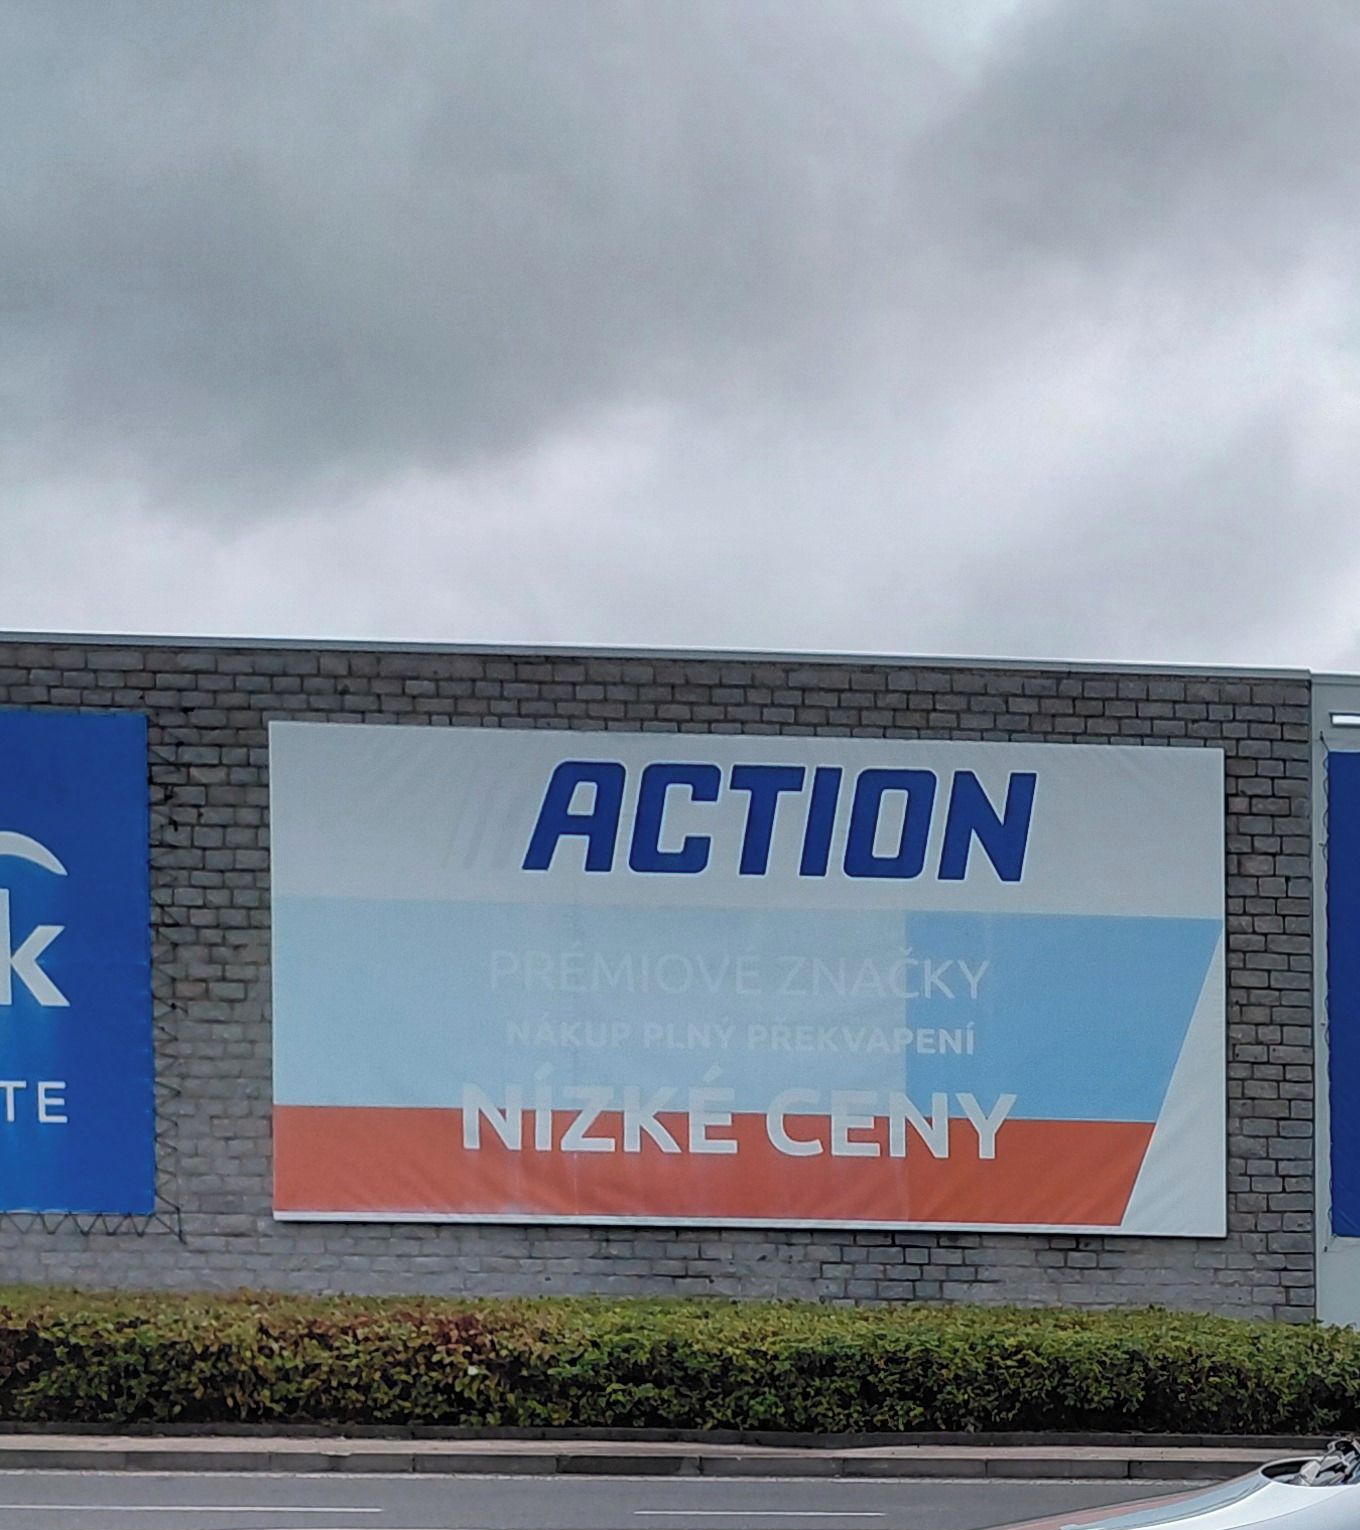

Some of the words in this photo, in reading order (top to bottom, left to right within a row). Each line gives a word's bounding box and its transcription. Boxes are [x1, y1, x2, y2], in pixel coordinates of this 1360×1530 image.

[521, 760, 1039, 883] ACTION
[490, 942, 764, 995] PRÉMIOVÉ
[780, 946, 991, 1000] ZNAČKY
[506, 1014, 632, 1048] NÁKUP
[643, 1016, 737, 1051] PLNÝ
[748, 1021, 977, 1055] PŘEKVAPENÍ
[462, 1061, 739, 1155] NÍZKÉ
[766, 1088, 1018, 1160] CENY
